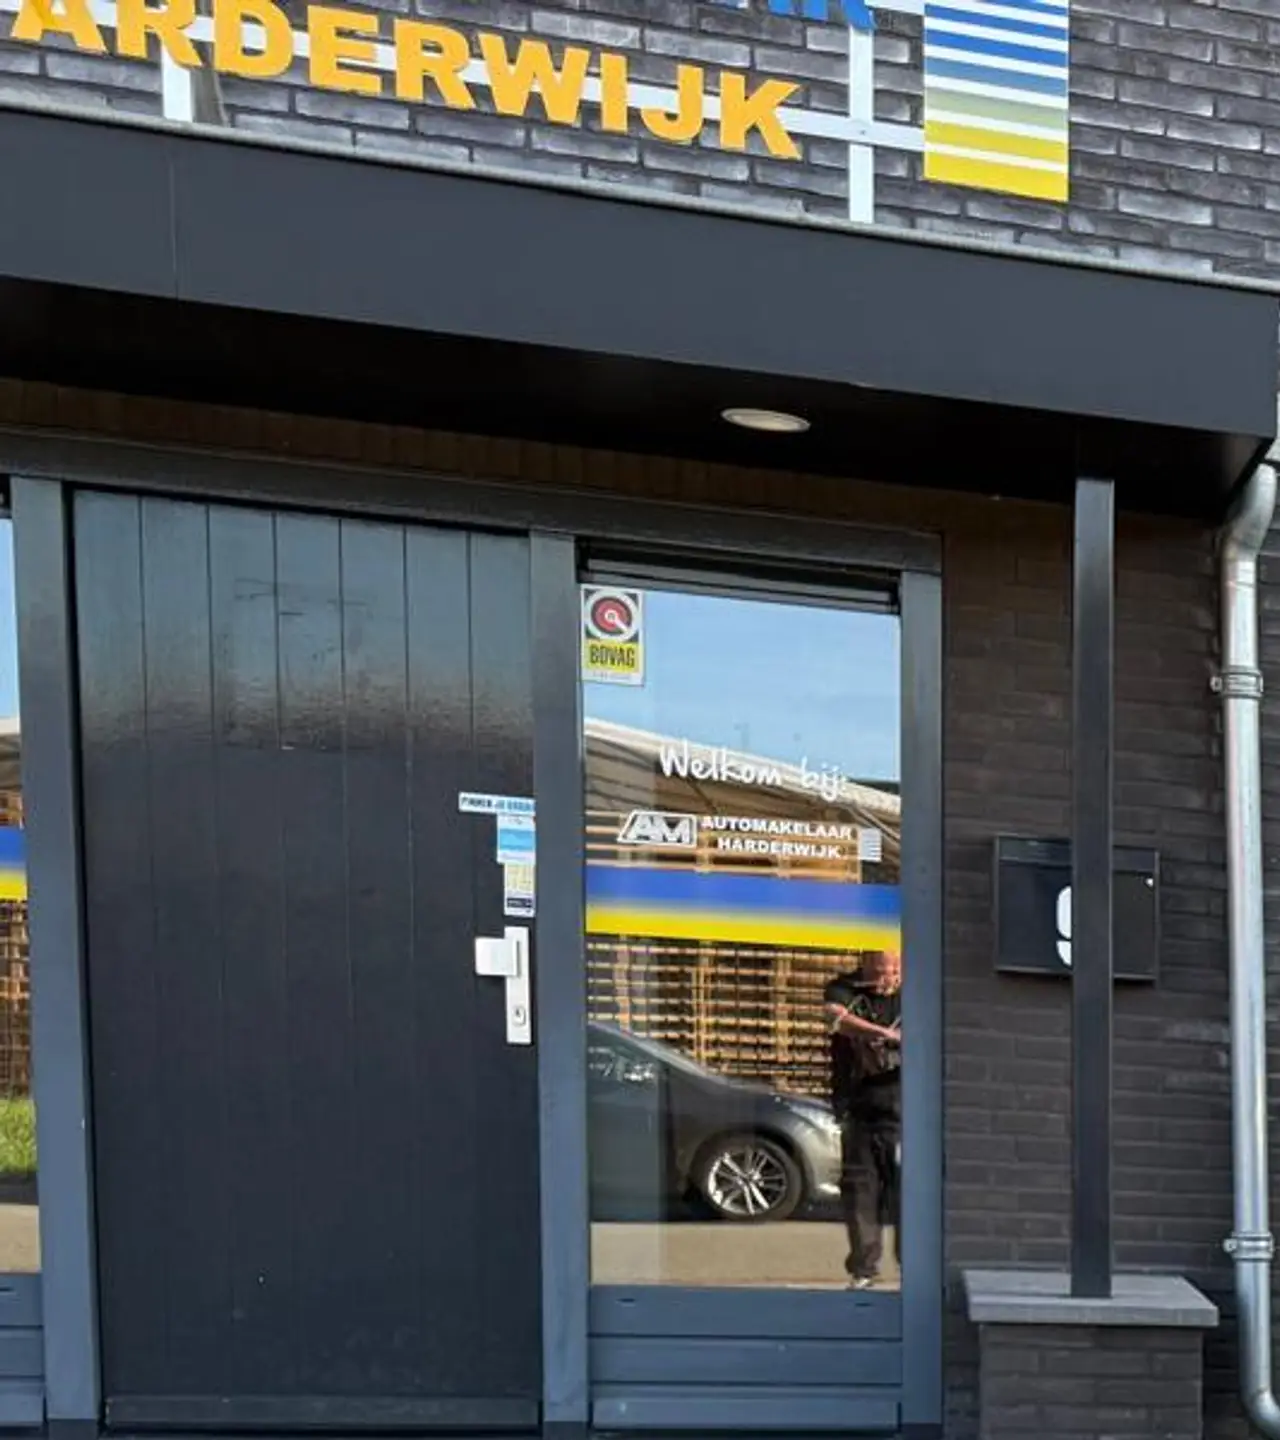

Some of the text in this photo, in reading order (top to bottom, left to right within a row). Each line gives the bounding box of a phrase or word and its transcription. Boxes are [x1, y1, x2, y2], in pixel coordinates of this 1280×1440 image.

[590, 643, 635, 669] BOVAG
[659, 738, 783, 786] Welkom
[700, 815, 852, 841] AUTOMAKELAAR
[717, 837, 841, 859] HARDERWIJK
